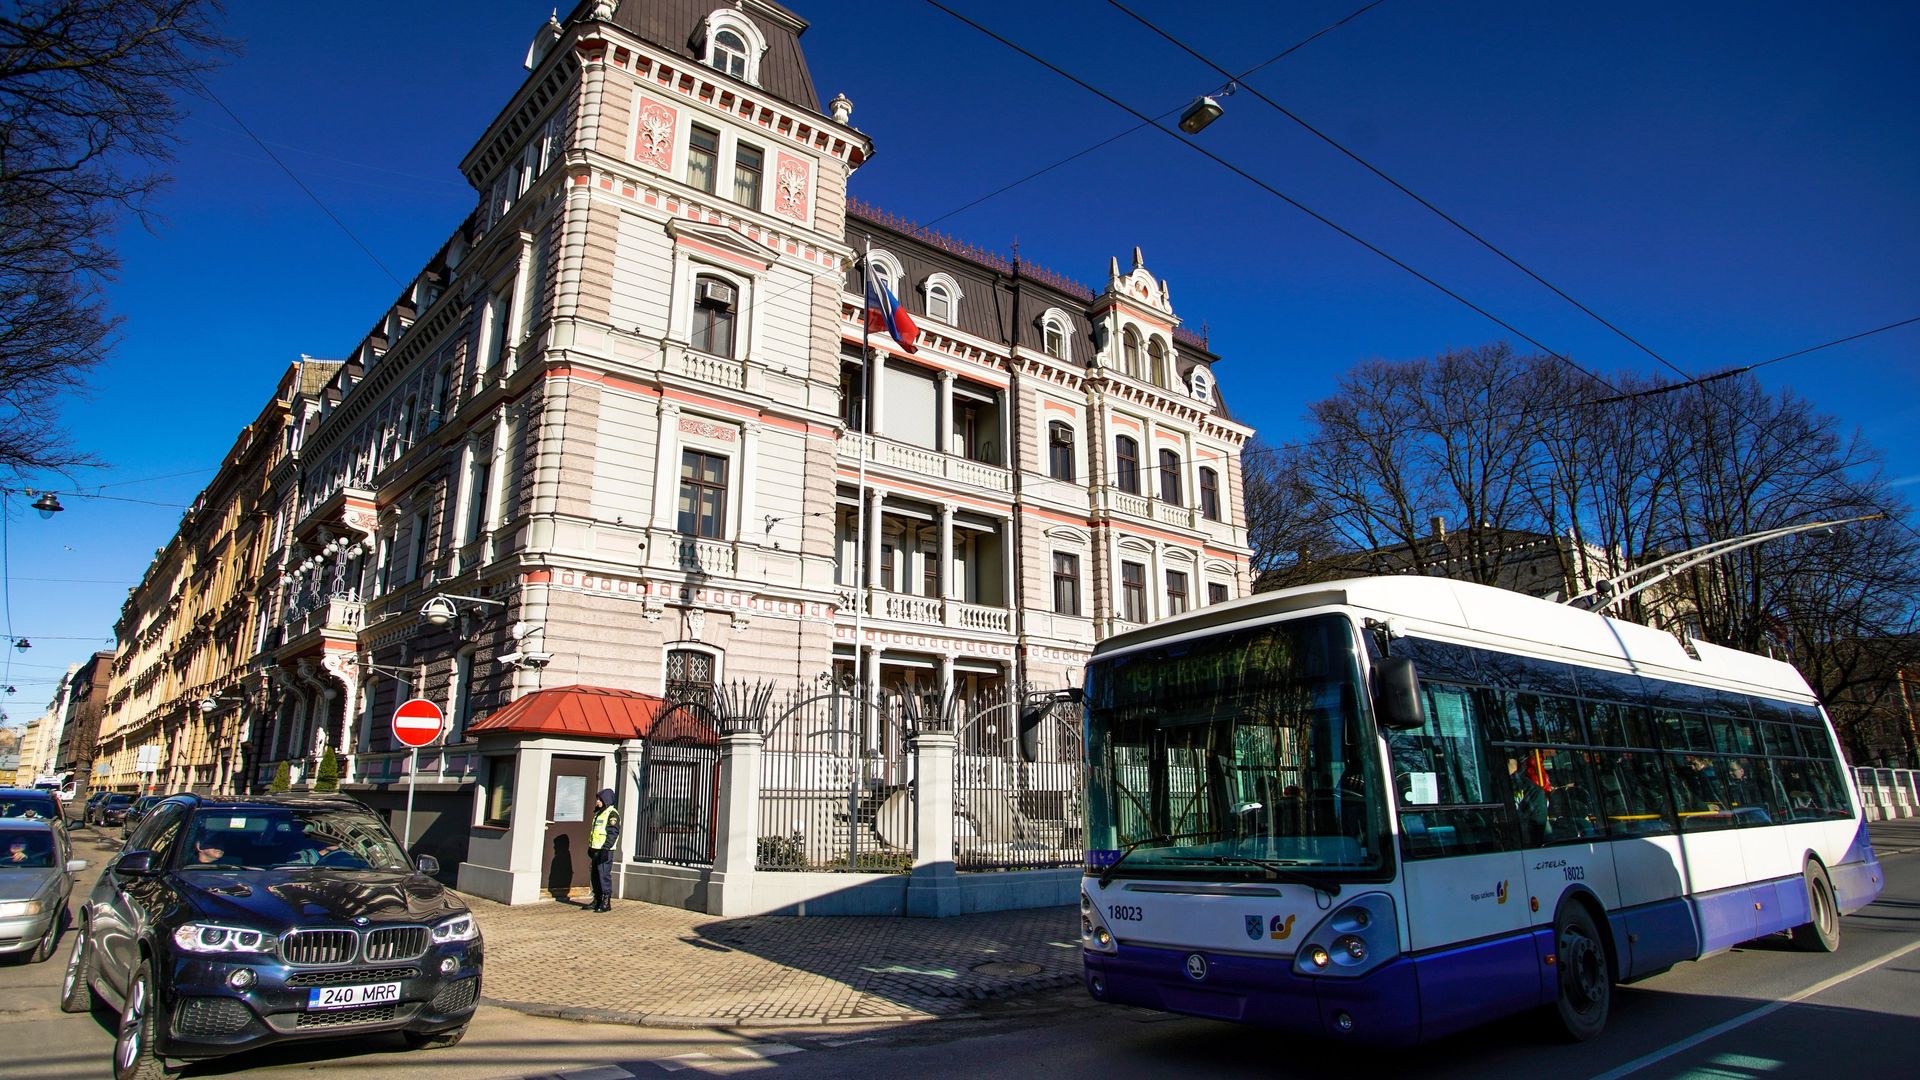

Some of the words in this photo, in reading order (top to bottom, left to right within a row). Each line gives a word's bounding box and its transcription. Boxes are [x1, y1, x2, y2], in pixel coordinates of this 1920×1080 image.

[1535, 859, 1567, 870] CITELIS
[1562, 865, 1585, 881] 18023
[1108, 904, 1143, 921] 18023
[324, 988, 354, 1004] 240
[362, 984, 397, 1001] MRR
